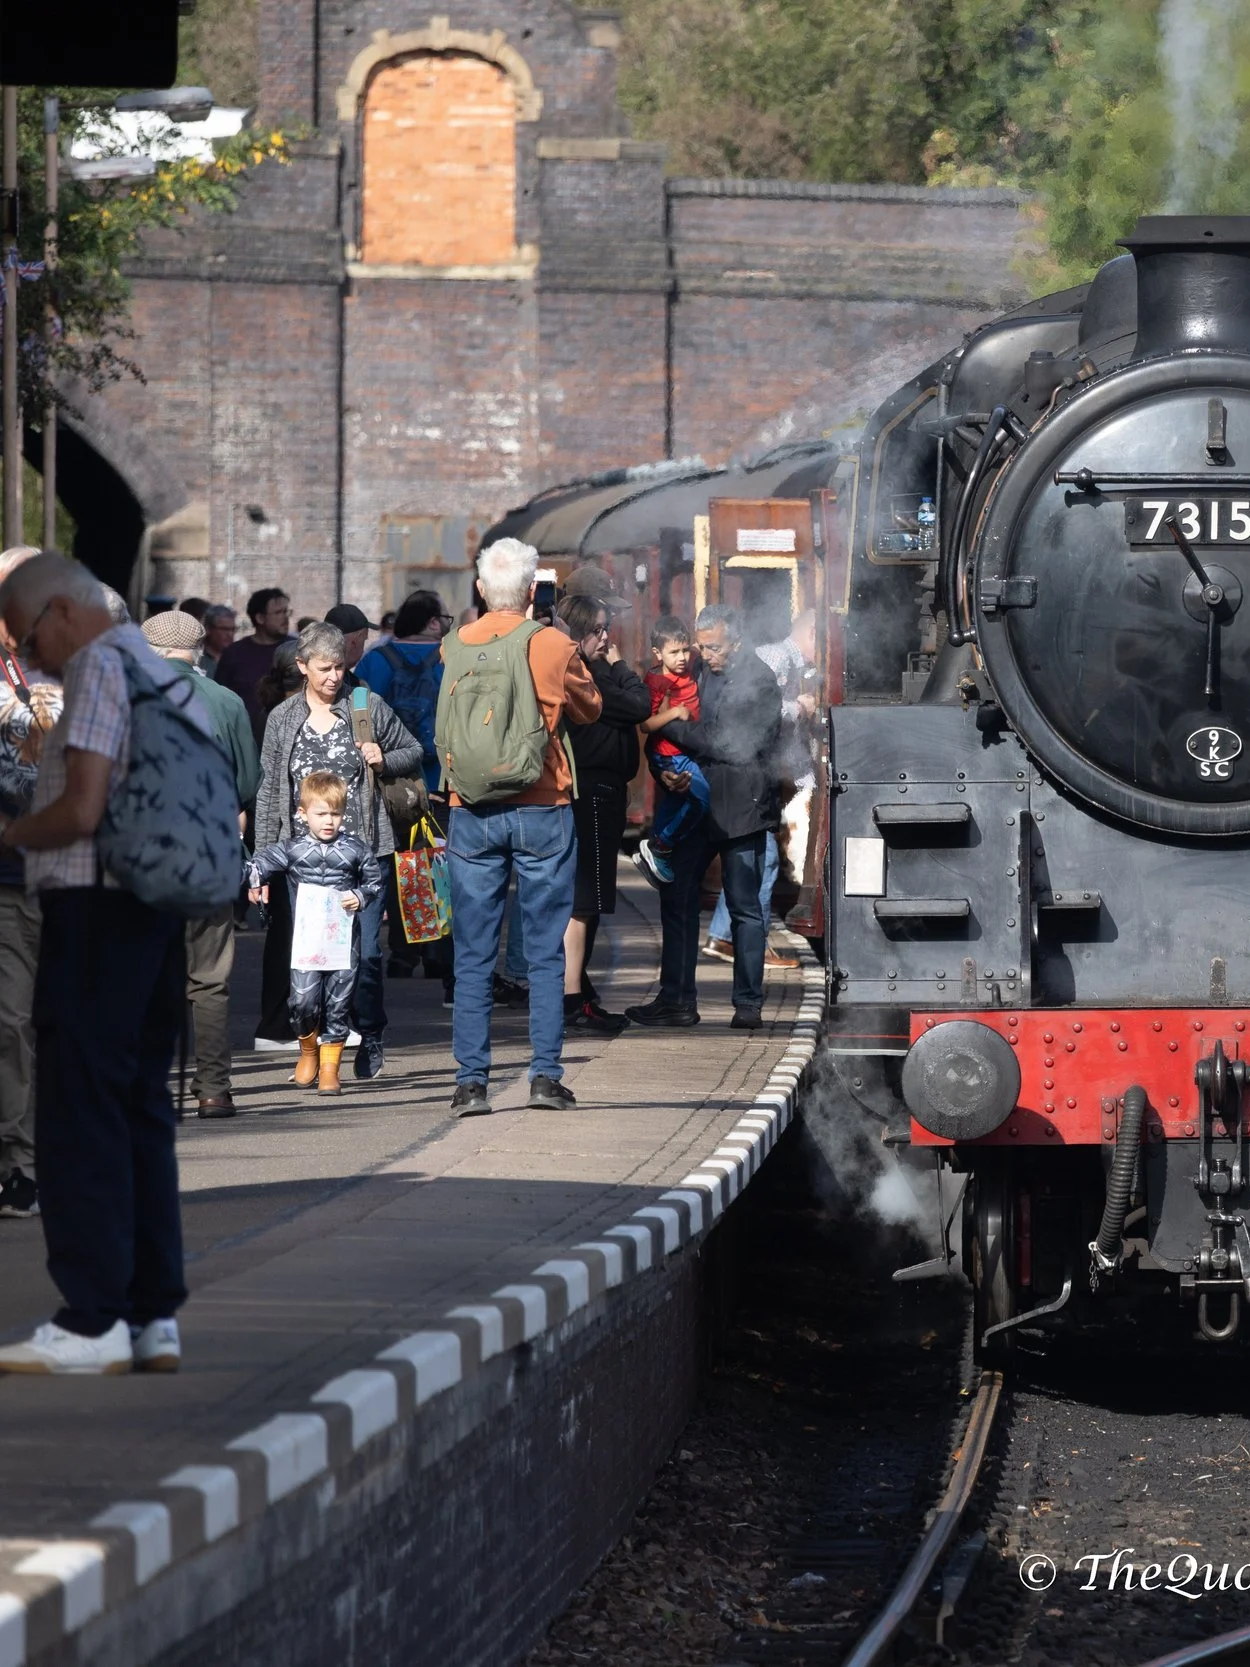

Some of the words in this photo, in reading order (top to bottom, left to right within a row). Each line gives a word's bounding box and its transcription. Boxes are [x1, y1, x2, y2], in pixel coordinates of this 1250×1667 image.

[1208, 730, 1219, 746] 9
[1209, 746, 1220, 760] K
[1200, 761, 1229, 777] SC
